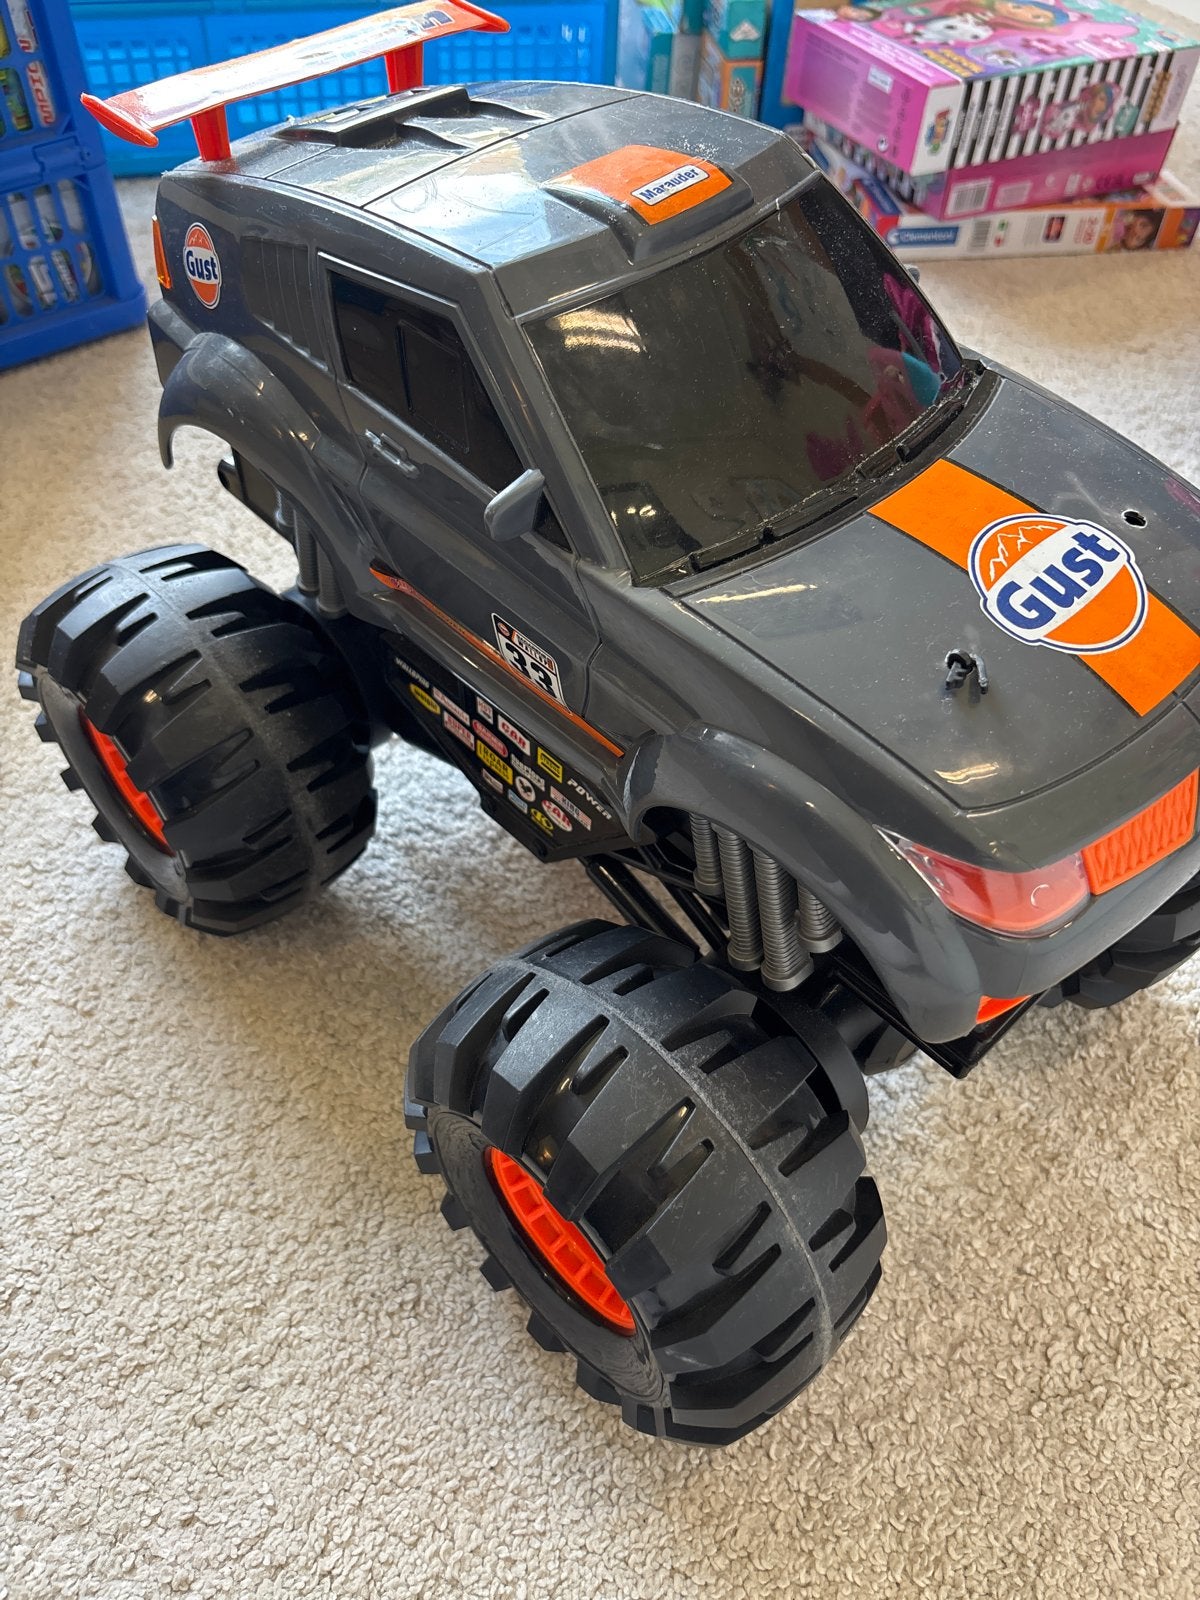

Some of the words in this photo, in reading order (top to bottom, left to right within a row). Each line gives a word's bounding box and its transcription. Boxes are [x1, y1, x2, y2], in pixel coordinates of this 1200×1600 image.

[640, 168, 699, 200] Marauder
[186, 250, 218, 281] Gust
[996, 531, 1121, 630] Gust
[505, 642, 557, 698] 33
[502, 721, 527, 750] CAR
[484, 746, 509, 772] ROAR
[542, 799, 572, 828] CAR
[567, 778, 612, 820] POWER
